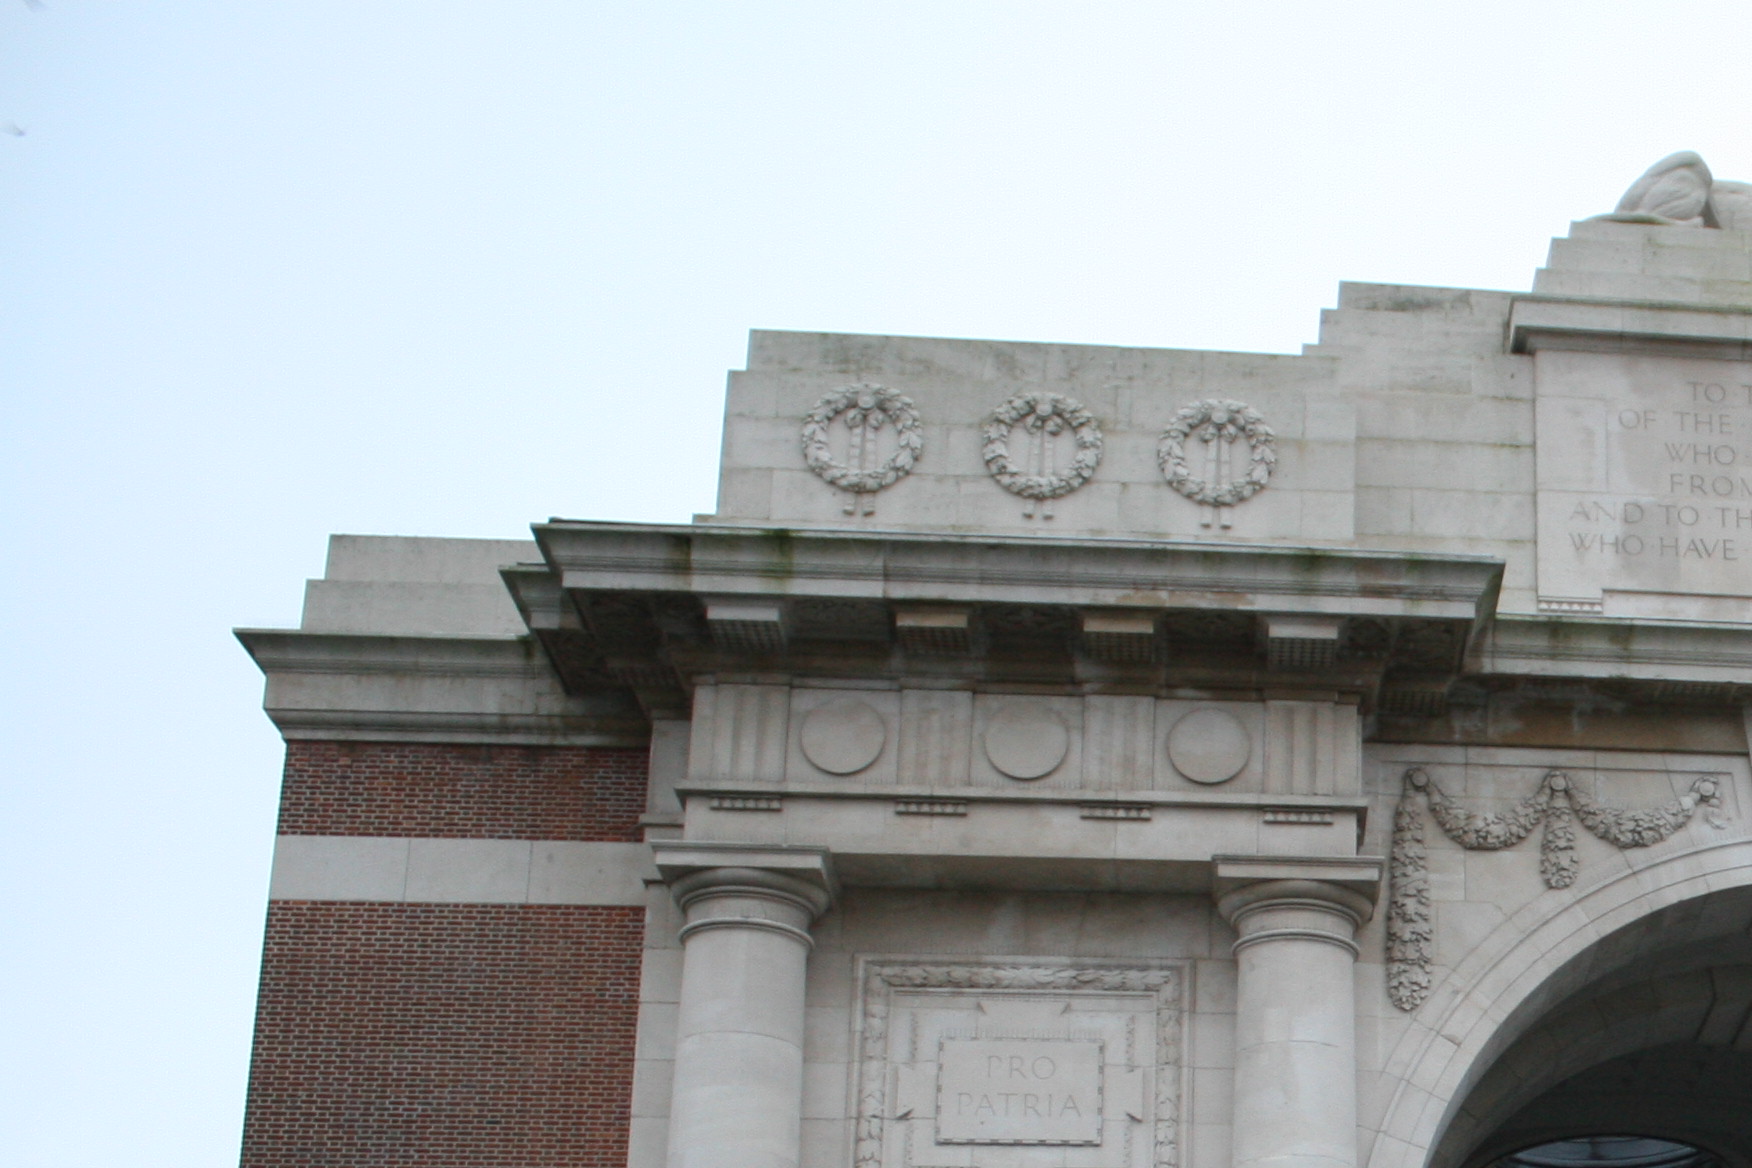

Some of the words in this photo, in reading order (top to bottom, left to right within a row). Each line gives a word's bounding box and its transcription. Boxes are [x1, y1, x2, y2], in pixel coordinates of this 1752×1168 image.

[1685, 382, 1726, 403] TO
[1618, 410, 1657, 429] OF
[1673, 411, 1733, 435] THE
[1664, 442, 1736, 465] WHO
[1569, 501, 1644, 524] AND
[1658, 504, 1699, 526] TO
[1568, 532, 1644, 556] WHO
[1660, 536, 1738, 560] HAVE
[987, 1055, 1056, 1079] PRO
[957, 1092, 1081, 1117] PATRIA
